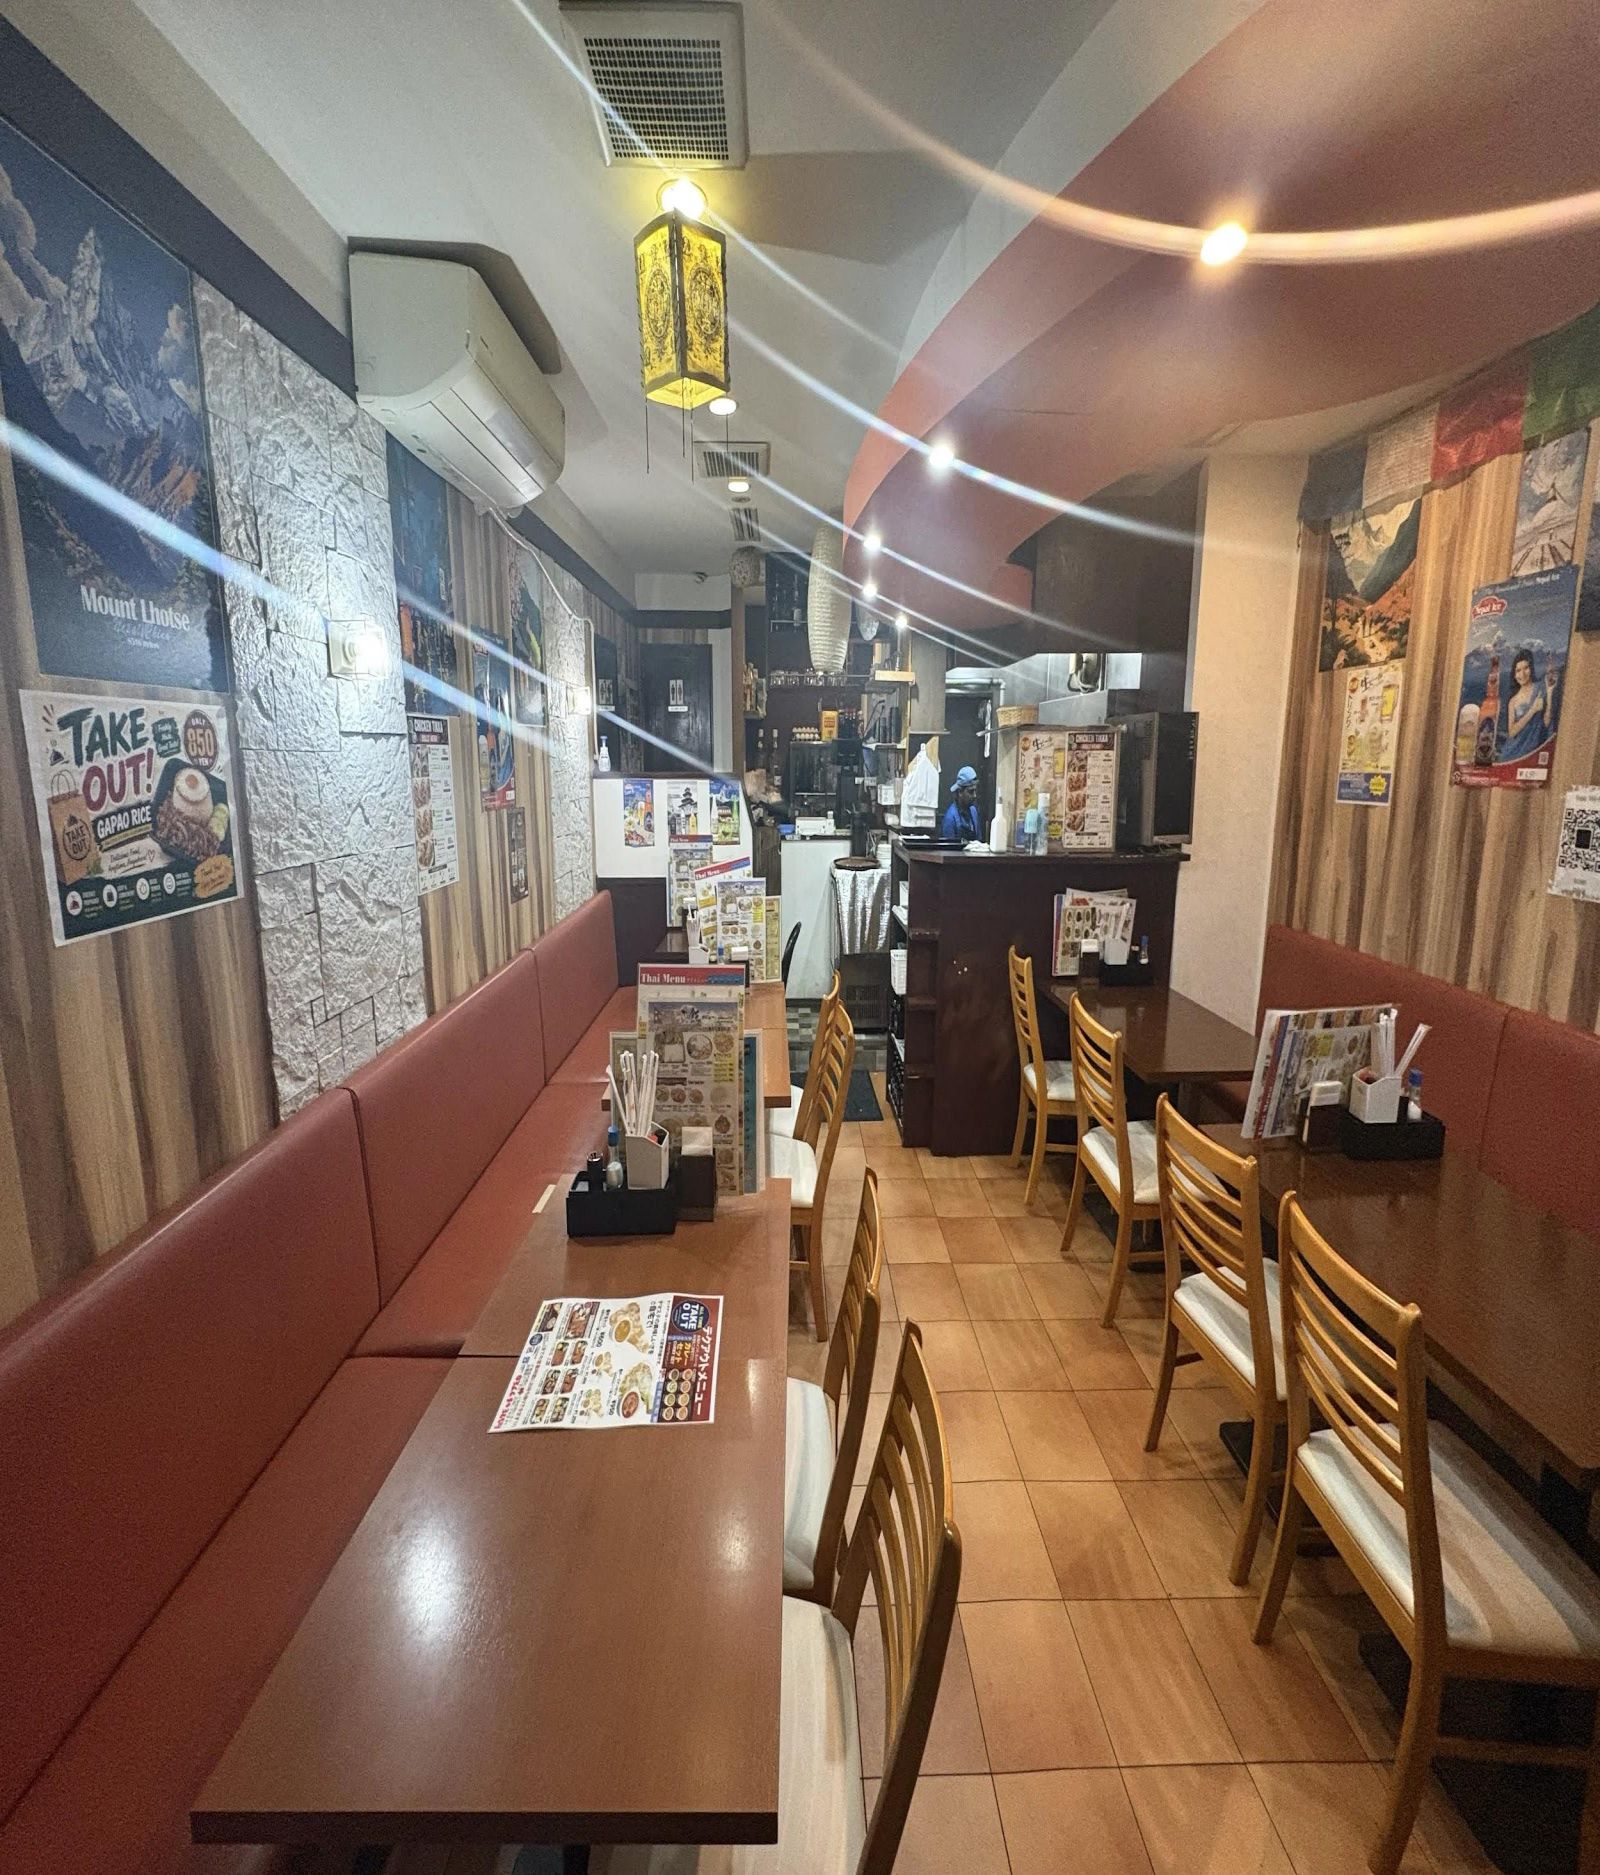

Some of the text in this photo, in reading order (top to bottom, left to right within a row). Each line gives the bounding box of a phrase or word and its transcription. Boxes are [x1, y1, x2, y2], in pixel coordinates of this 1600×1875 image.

[80, 584, 137, 621] Mount
[139, 598, 191, 631] Lhotse
[191, 717, 206, 727] ONLY
[57, 706, 149, 768] TAKE
[186, 729, 215, 757] 850
[198, 757, 209, 767] YEN
[81, 748, 155, 813] OUT!
[65, 826, 86, 843] TAKE
[96, 813, 131, 839] GAPAO
[131, 805, 152, 828] RICE
[70, 840, 89, 856] OUT
[641, 973, 686, 983] Thai Menu
[680, 1302, 691, 1330] OUT
[688, 1303, 699, 1330] TAKE
[674, 1341, 683, 1363] セット
[682, 1342, 692, 1366] カレー
